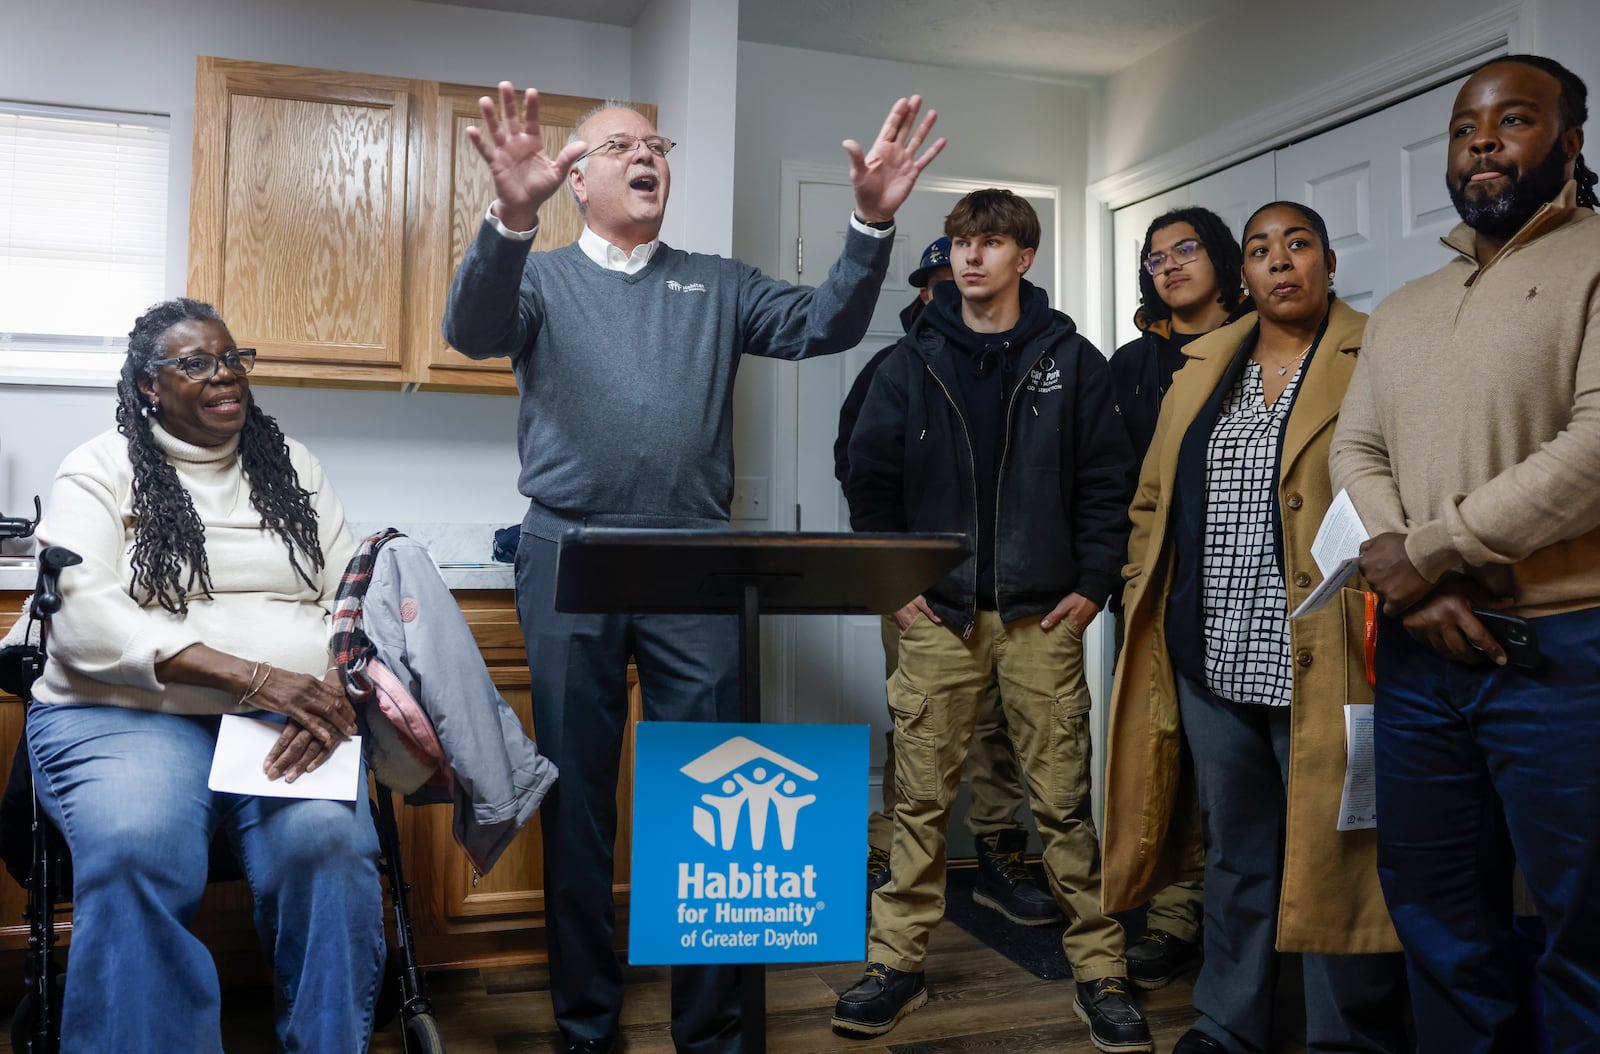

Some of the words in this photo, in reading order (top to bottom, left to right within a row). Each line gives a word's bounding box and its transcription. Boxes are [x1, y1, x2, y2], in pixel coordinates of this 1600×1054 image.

[1046, 369, 1060, 381] Park
[1026, 384, 1062, 392] COSTRUCTION
[677, 862, 817, 899] Habitat
[677, 902, 708, 924] for
[680, 929, 698, 947] of
[701, 929, 760, 947] Greater
[764, 928, 818, 950] Dayton
